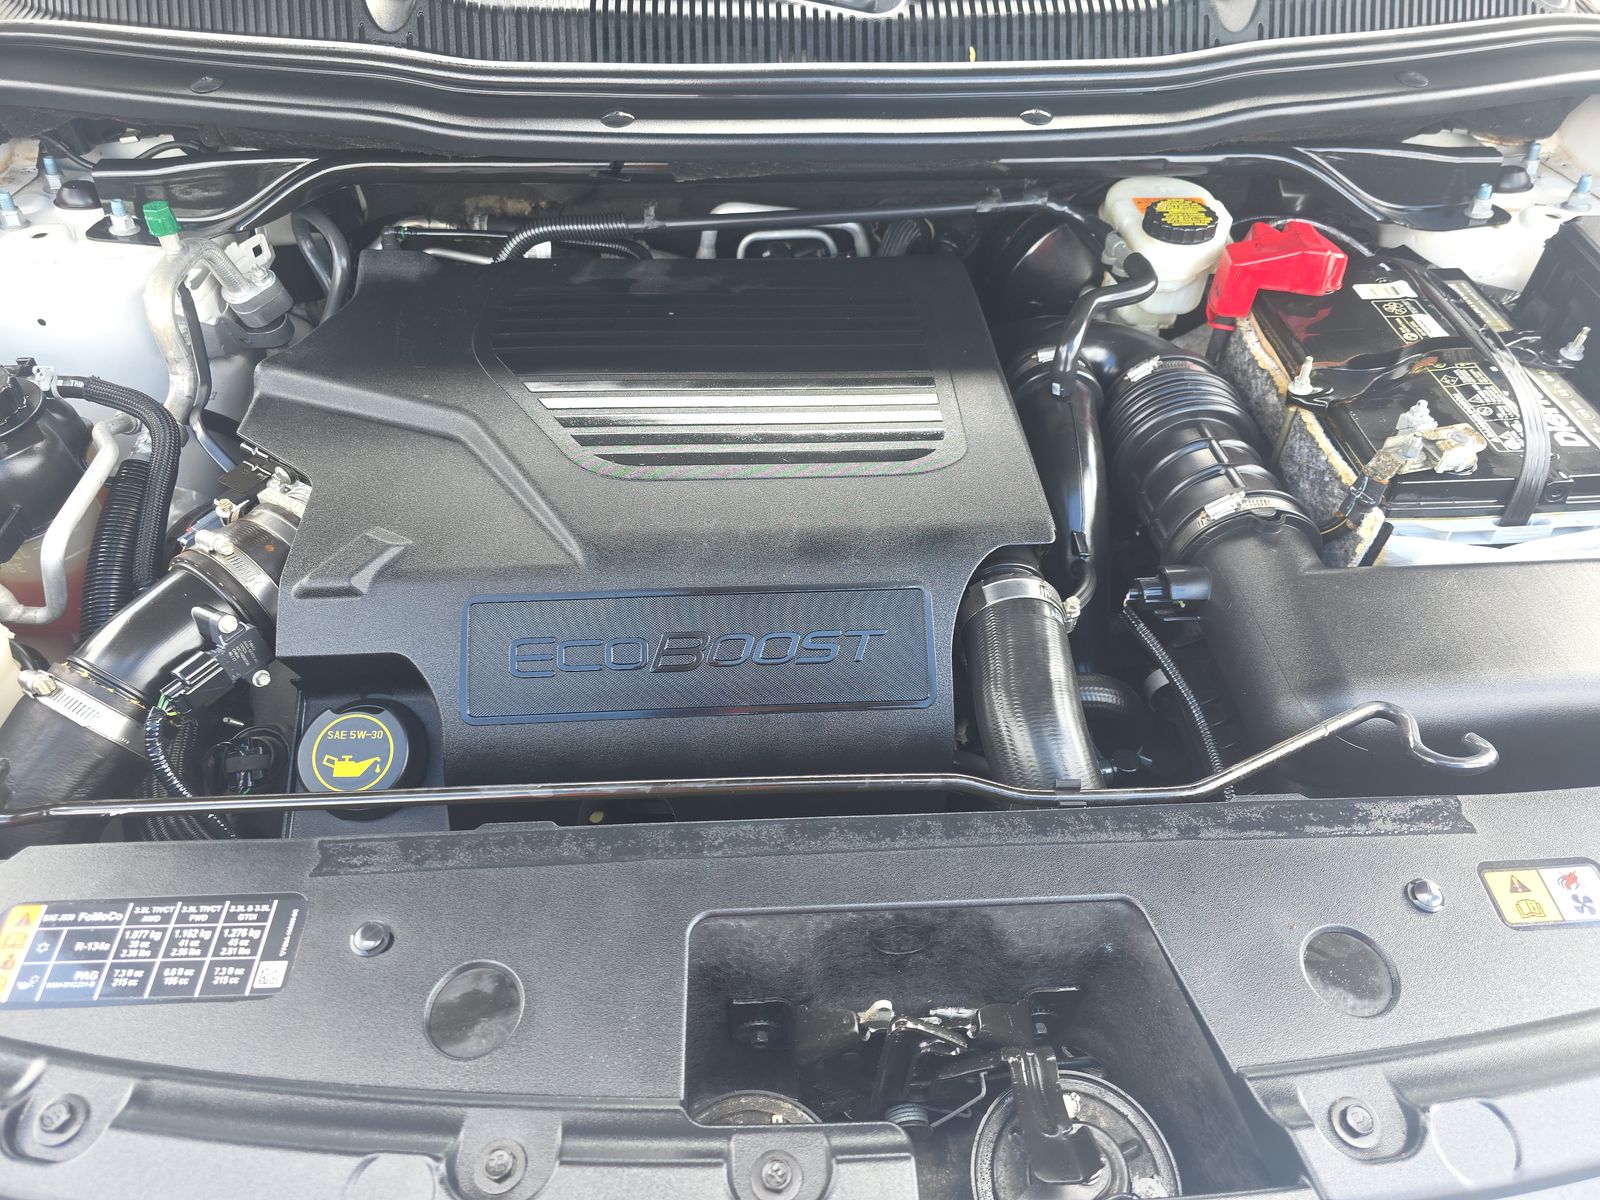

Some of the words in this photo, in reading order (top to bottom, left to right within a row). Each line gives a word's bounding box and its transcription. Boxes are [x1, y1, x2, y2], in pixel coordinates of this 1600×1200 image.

[508, 629, 888, 678] ECOBOOST
[327, 730, 347, 740] SAE
[349, 730, 384, 740] 5W-30
[77, 911, 124, 922] FoMoCo
[189, 914, 209, 922] FWD
[149, 930, 163, 942] kg
[199, 928, 212, 940] kg
[248, 928, 262, 940] kg
[138, 949, 151, 957] lbs
[188, 948, 202, 956] lbs
[113, 969, 127, 977] 7.3
[214, 967, 228, 976] 7.3
[179, 977, 189, 985] cc
[212, 976, 229, 985] 215
[229, 976, 240, 984] cc
